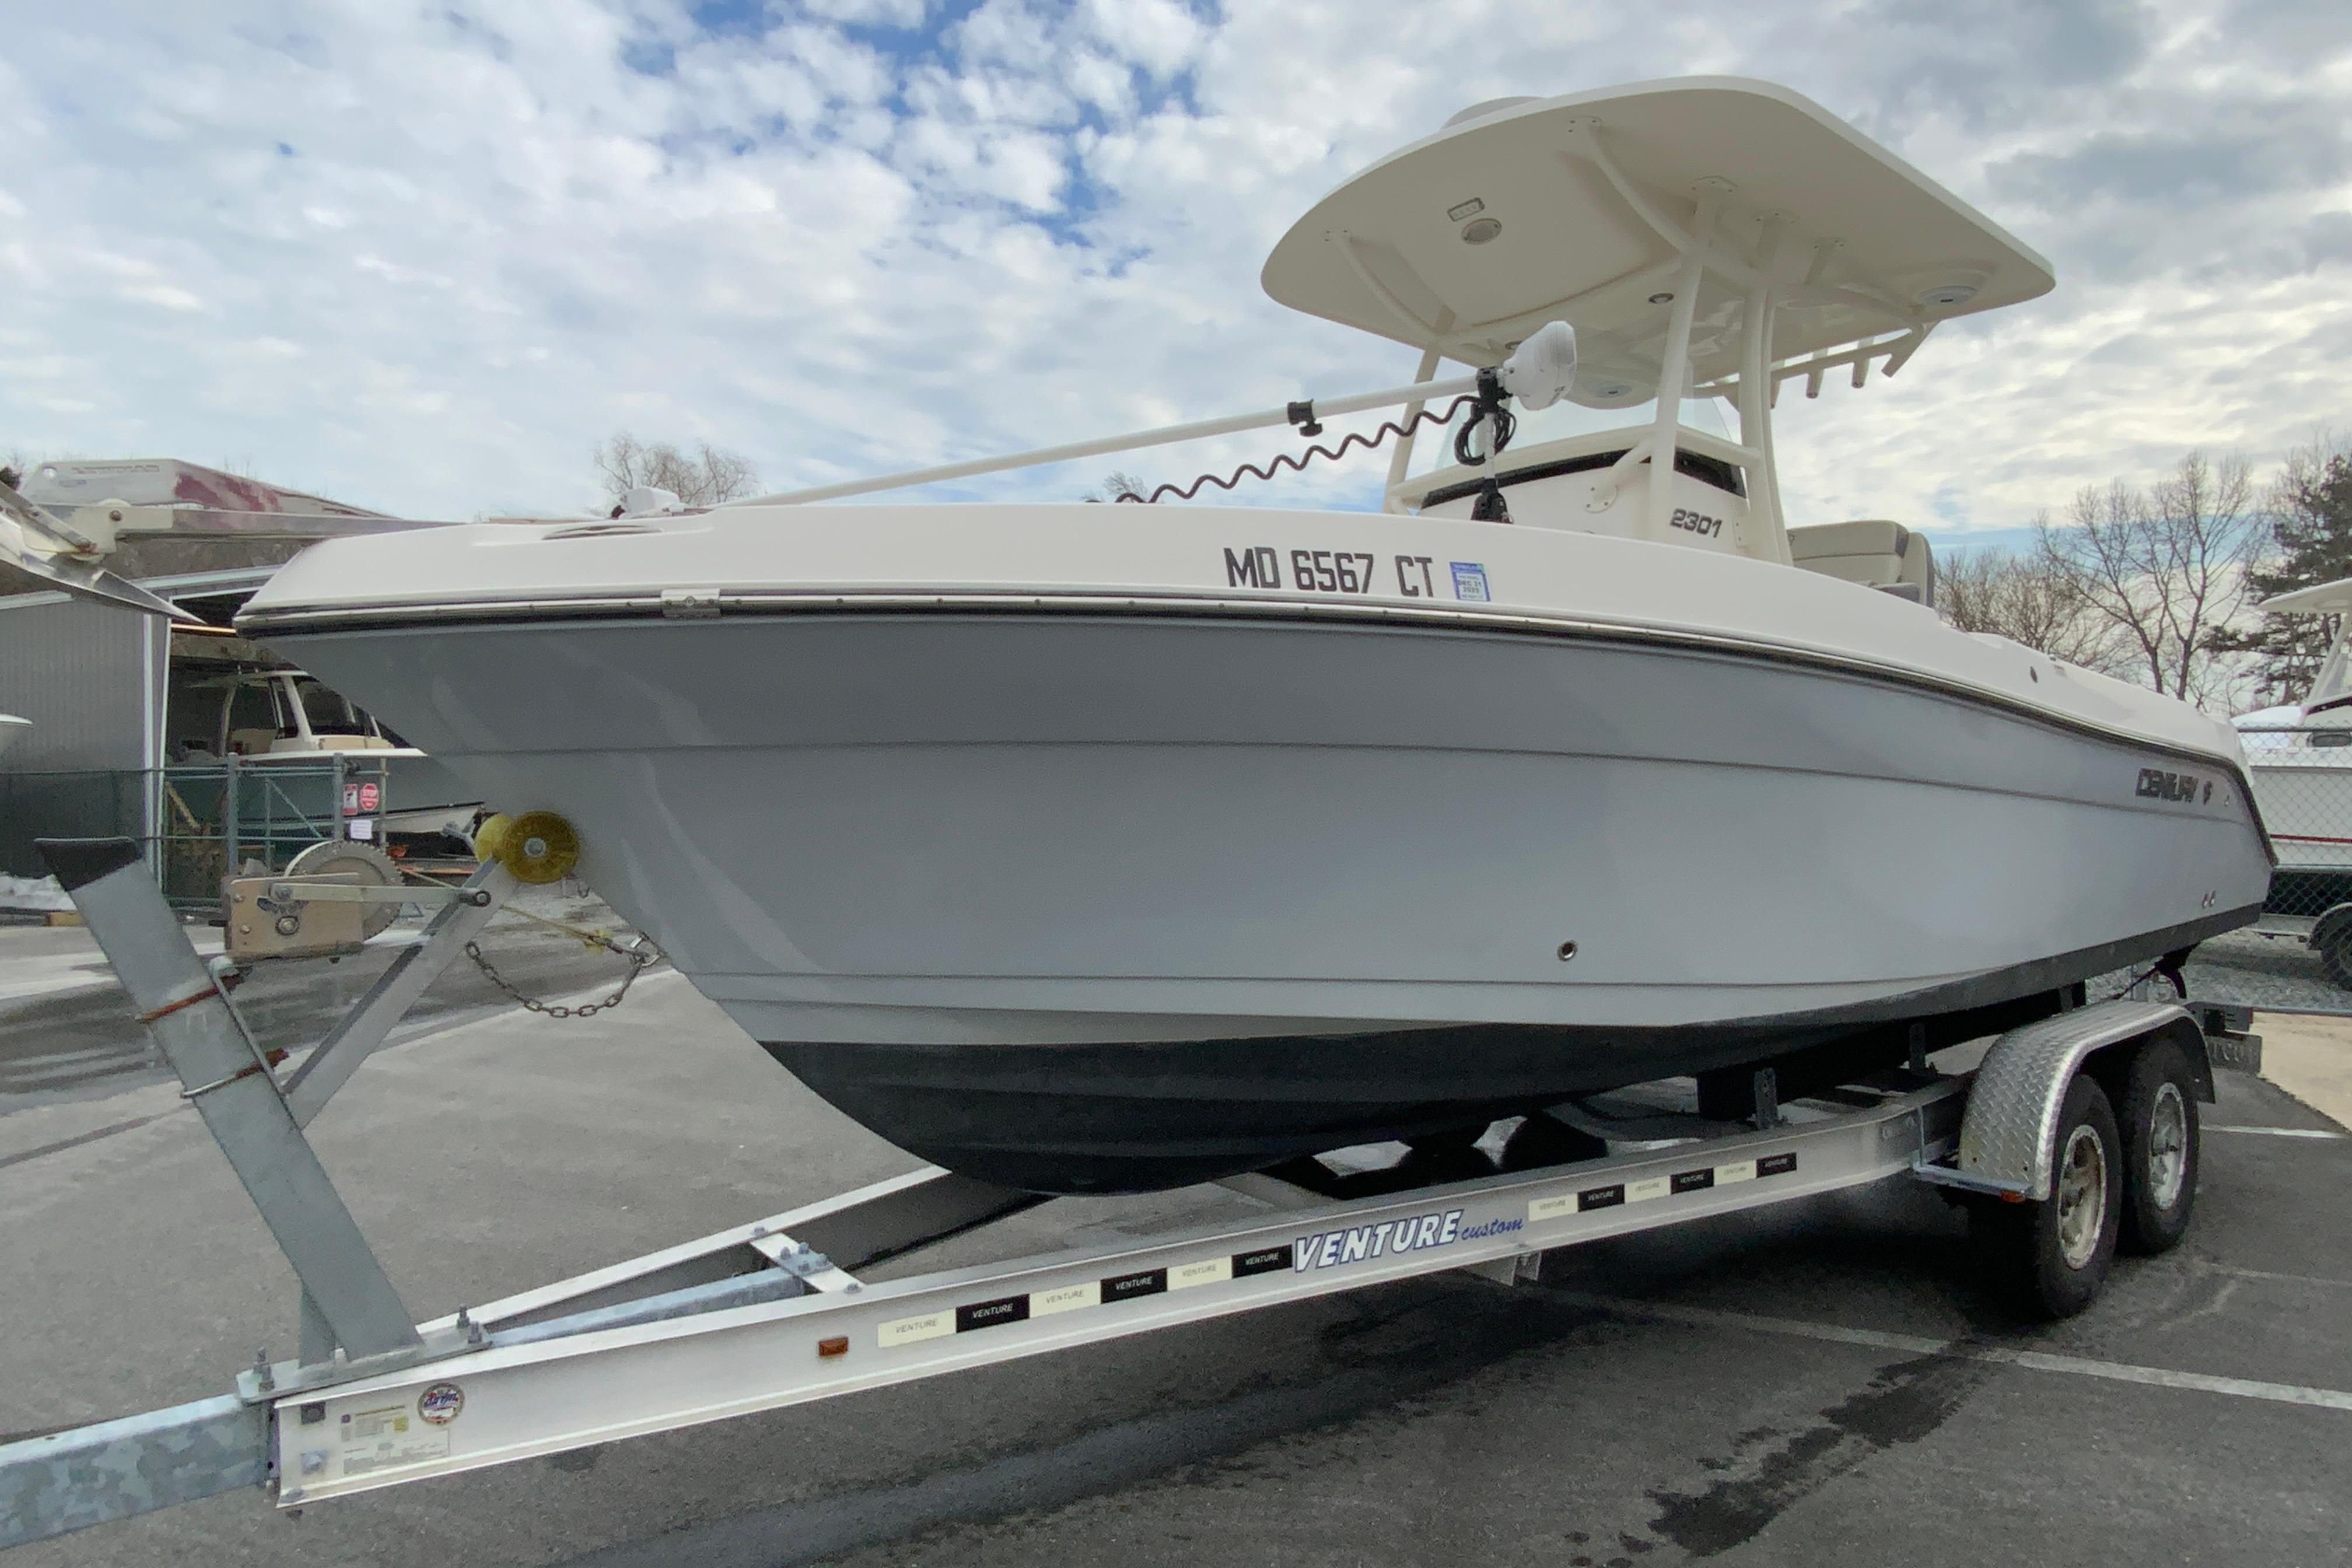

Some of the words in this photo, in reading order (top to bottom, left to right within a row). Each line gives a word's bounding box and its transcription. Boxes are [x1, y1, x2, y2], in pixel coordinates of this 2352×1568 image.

[1670, 508, 1723, 538] 2301
[1223, 547, 1280, 588] MD
[1290, 550, 1374, 594] 6567
[1394, 555, 1434, 598] CT
[1295, 1209, 1465, 1273] VENTURE
[1461, 1217, 1523, 1241] custom
[1245, 1252, 1279, 1265] VENTURE
[1182, 1264, 1216, 1278] VENTURE
[1115, 1276, 1153, 1290] VENTURE
[1046, 1289, 1084, 1304] VENTURE
[971, 1303, 1013, 1319] VENTURE
[895, 1318, 938, 1334] VENTURE
